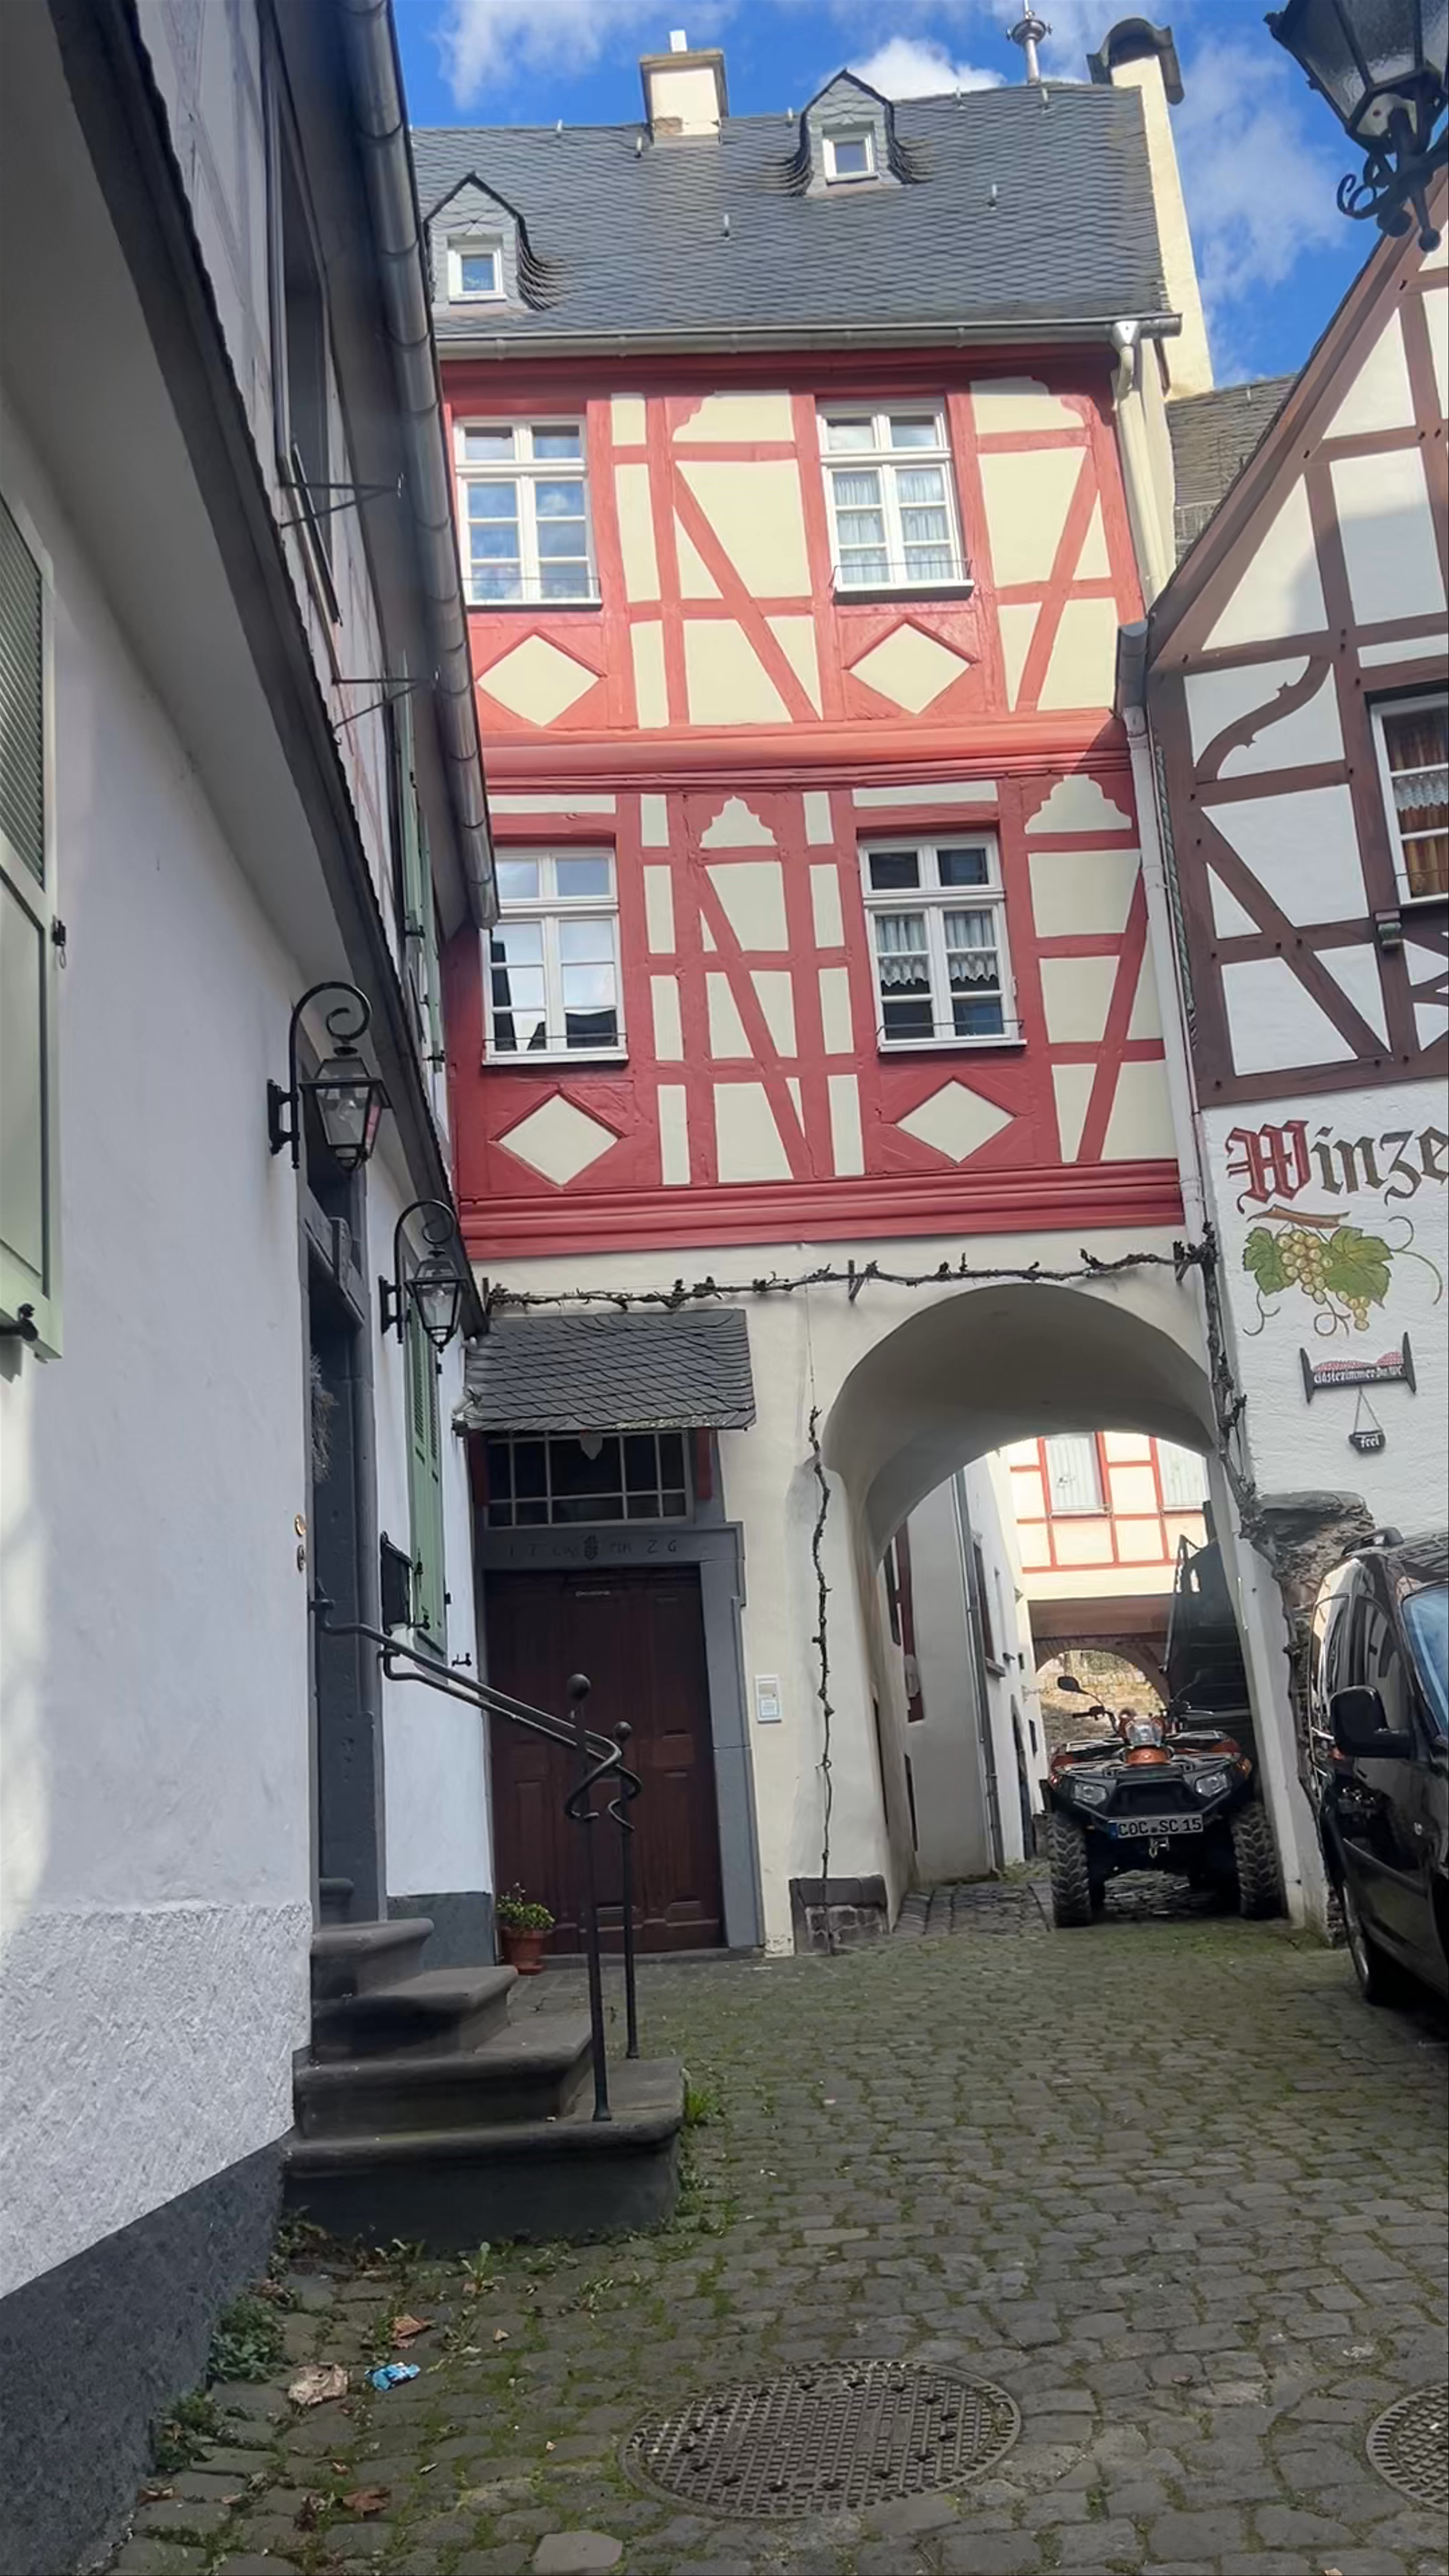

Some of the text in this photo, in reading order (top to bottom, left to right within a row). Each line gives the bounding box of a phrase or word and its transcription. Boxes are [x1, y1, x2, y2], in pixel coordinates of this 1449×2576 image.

[1118, 1818, 1202, 1836] COC SC 15
